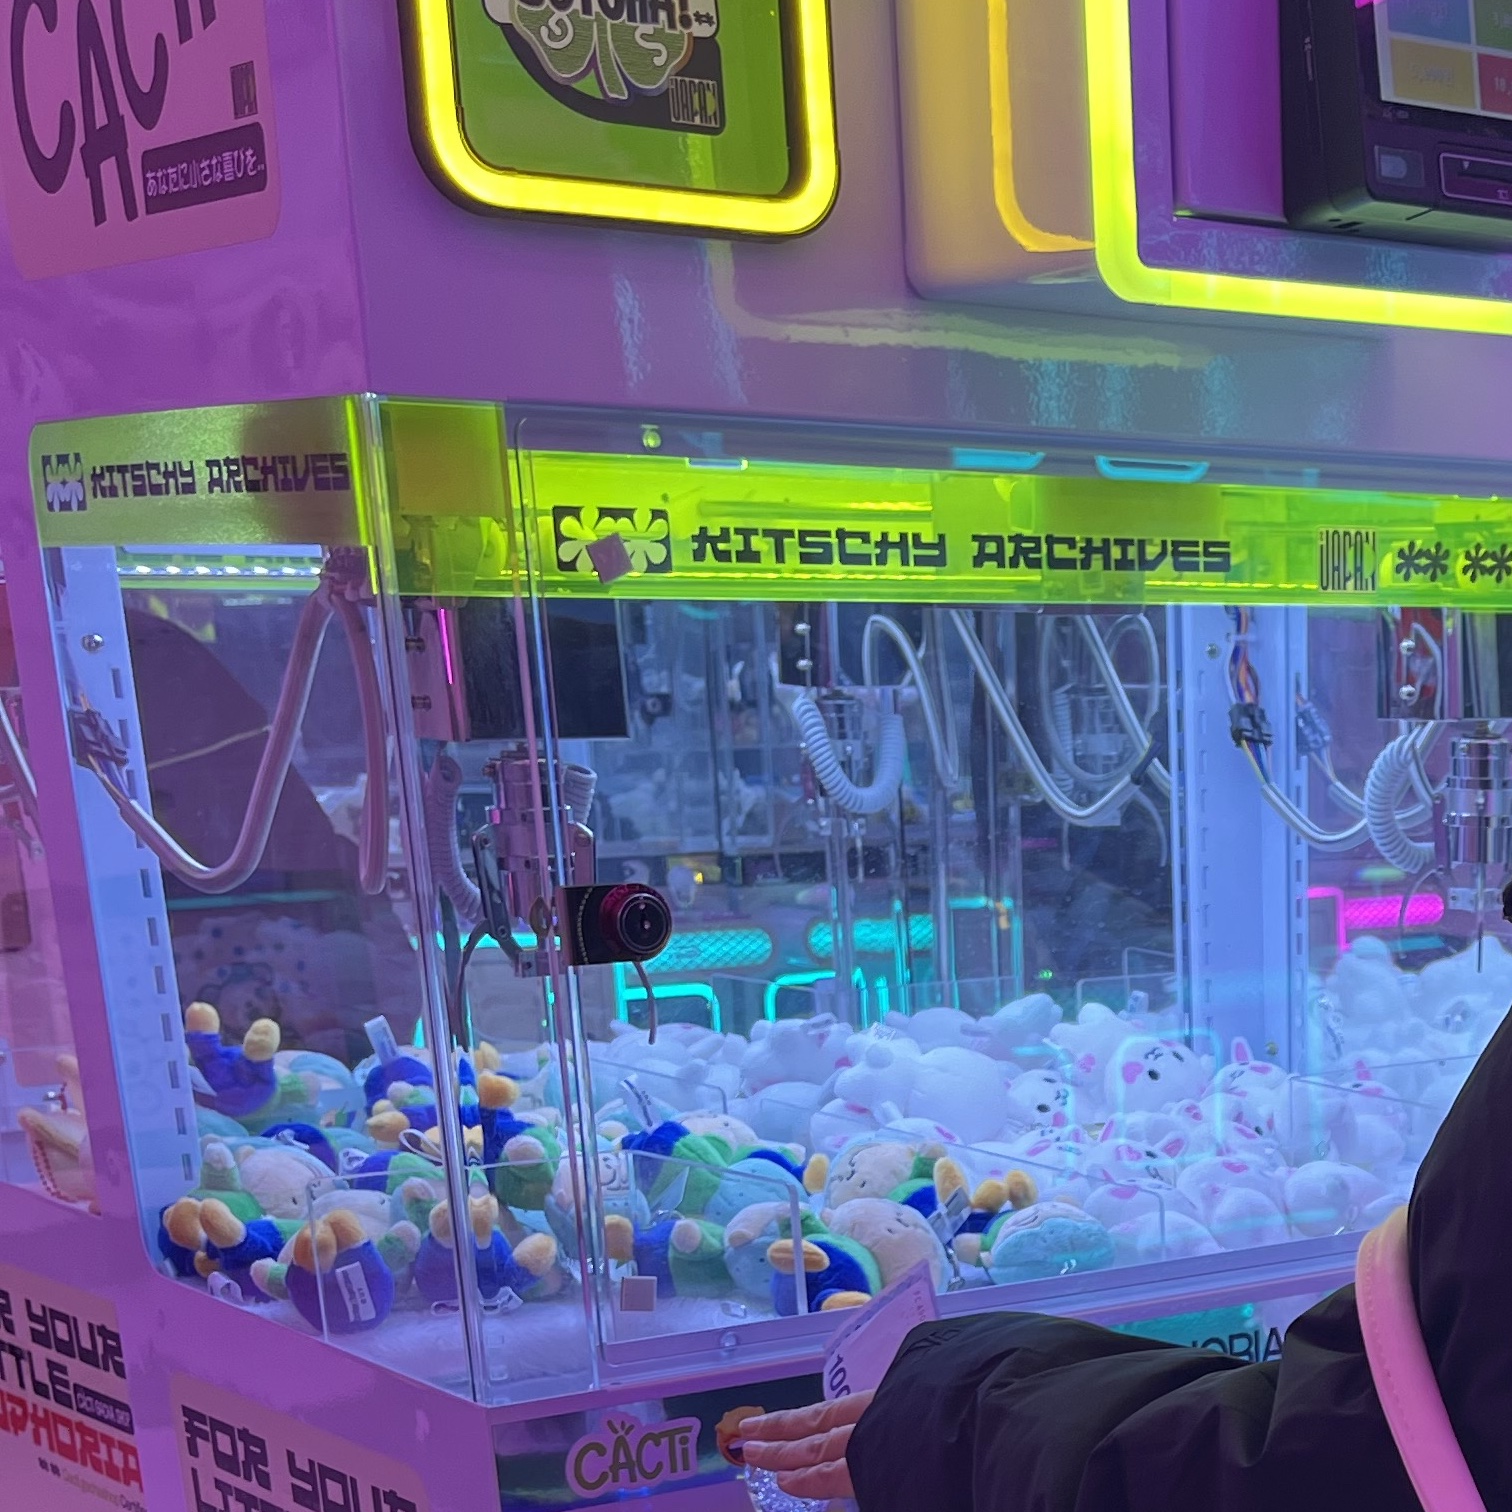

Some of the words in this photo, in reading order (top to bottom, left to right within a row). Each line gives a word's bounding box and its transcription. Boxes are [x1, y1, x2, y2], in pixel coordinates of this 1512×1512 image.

[10, 0, 217, 228] CAC
[90, 460, 197, 499] KITSCHY
[205, 452, 351, 494] ARCHIVES
[691, 526, 947, 568] KITSCHY
[971, 532, 1231, 573] ARCHIVES
[25, 1298, 127, 1379] YOUR
[181, 1404, 271, 1491] FOR
